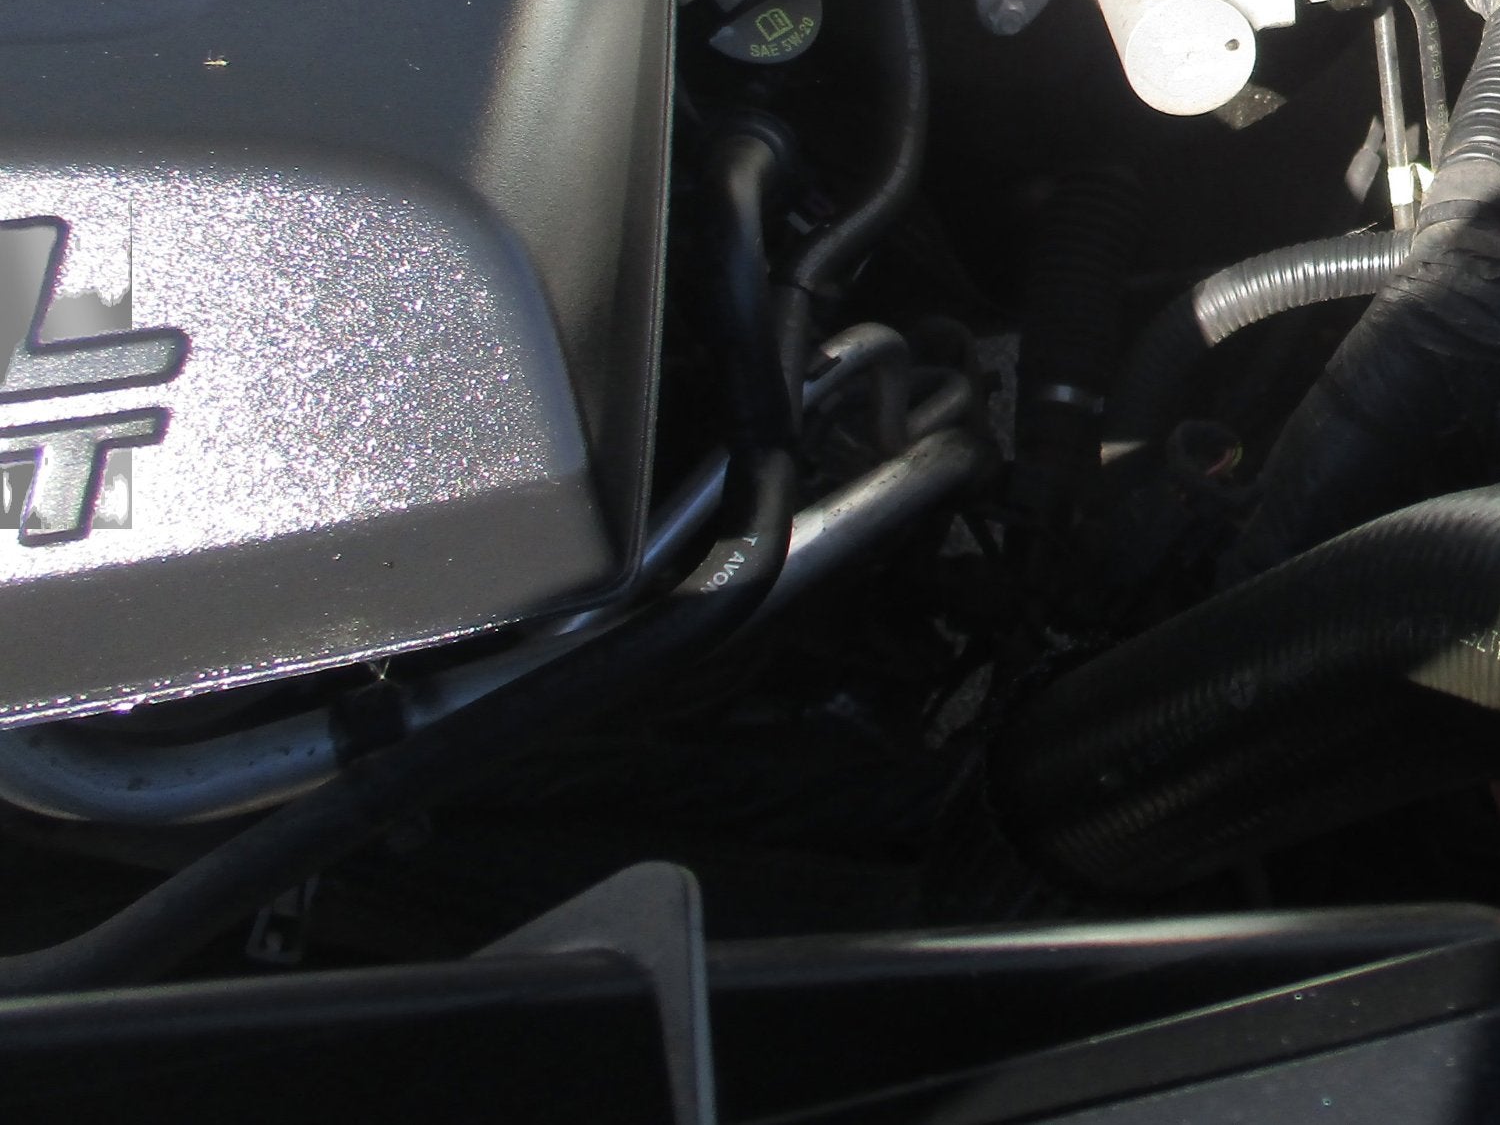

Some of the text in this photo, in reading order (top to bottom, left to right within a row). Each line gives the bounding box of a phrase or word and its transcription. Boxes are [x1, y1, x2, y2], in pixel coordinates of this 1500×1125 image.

[750, 17, 814, 57] SAE 5W-20
[700, 550, 745, 593] AVON
